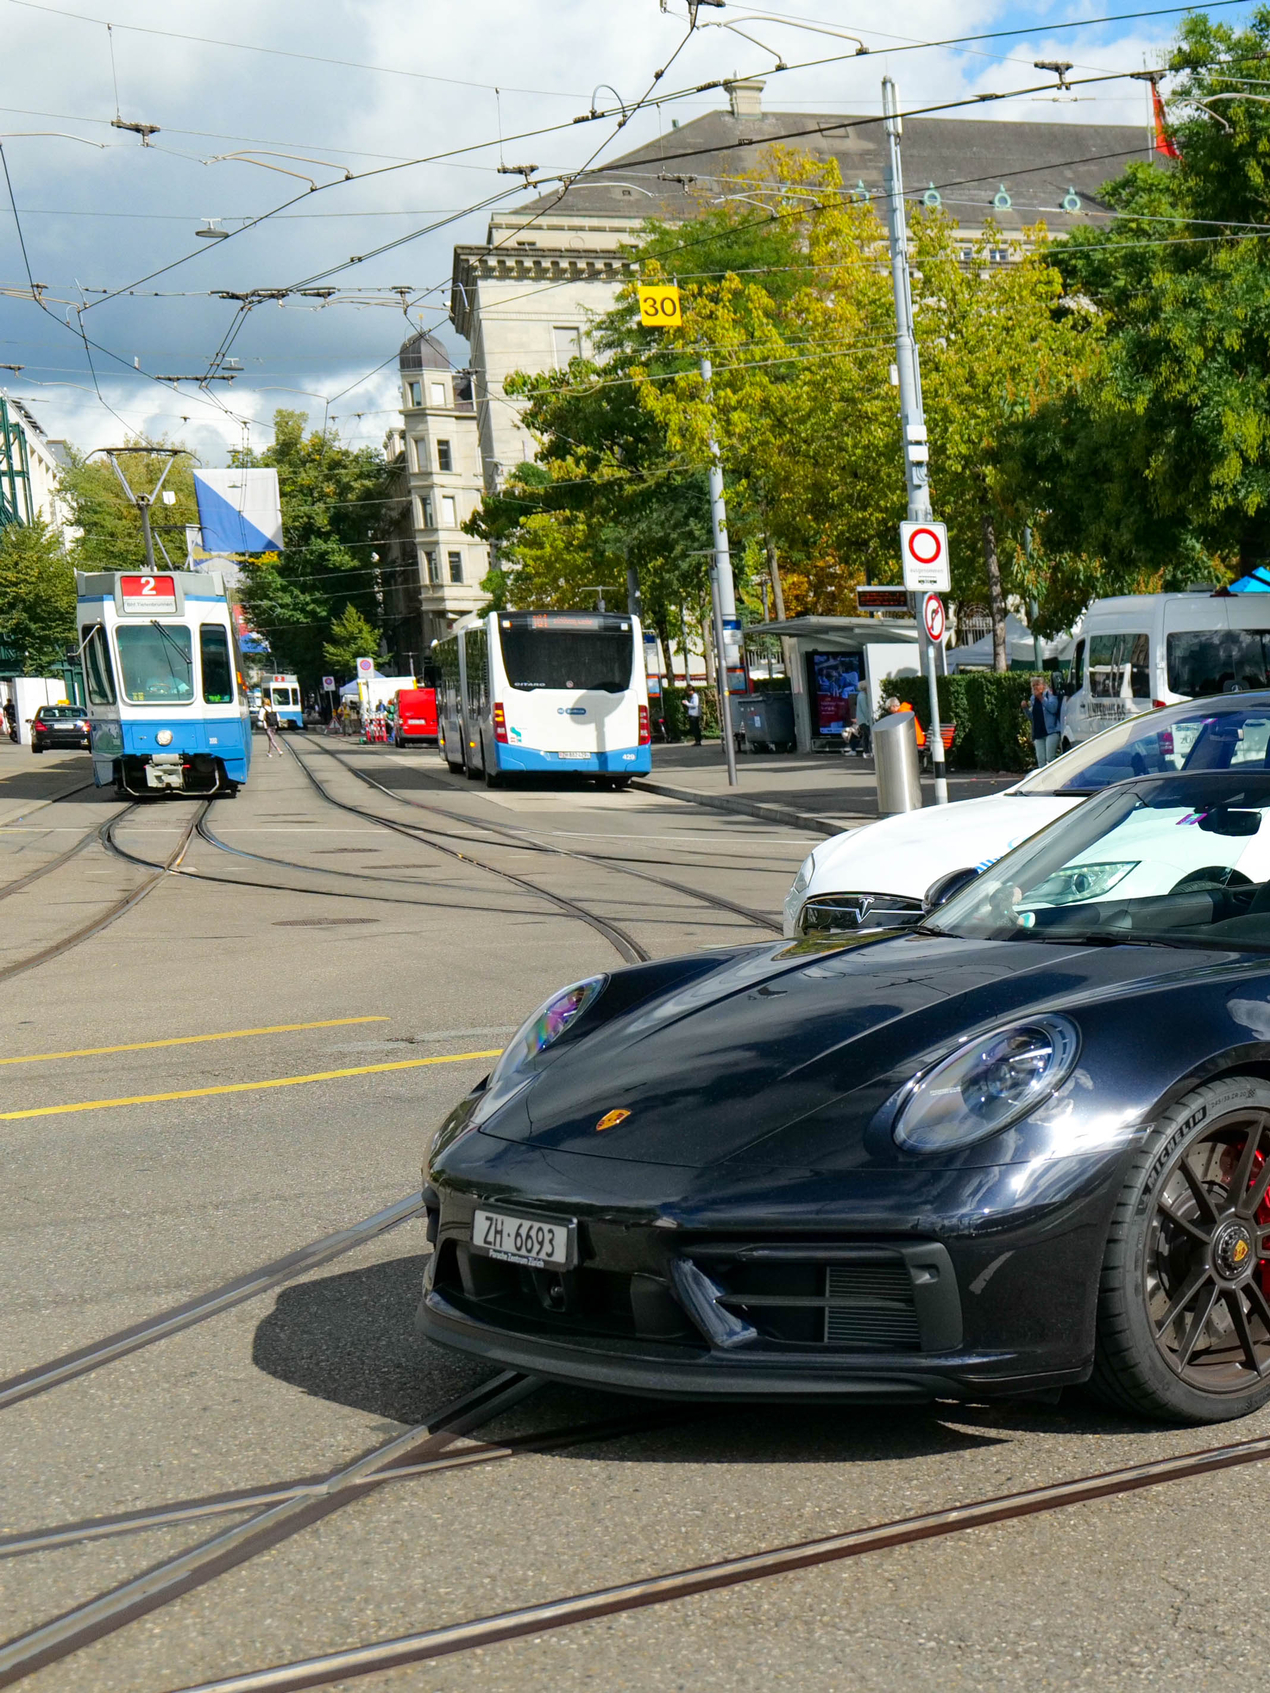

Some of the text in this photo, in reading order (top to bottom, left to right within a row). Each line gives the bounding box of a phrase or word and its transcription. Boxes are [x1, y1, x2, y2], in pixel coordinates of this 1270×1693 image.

[643, 296, 677, 317] 30
[140, 576, 157, 595] 2
[1147, 1108, 1206, 1190] MICHELIN
[489, 1249, 545, 1268] Porsche Zentrum Zürich
